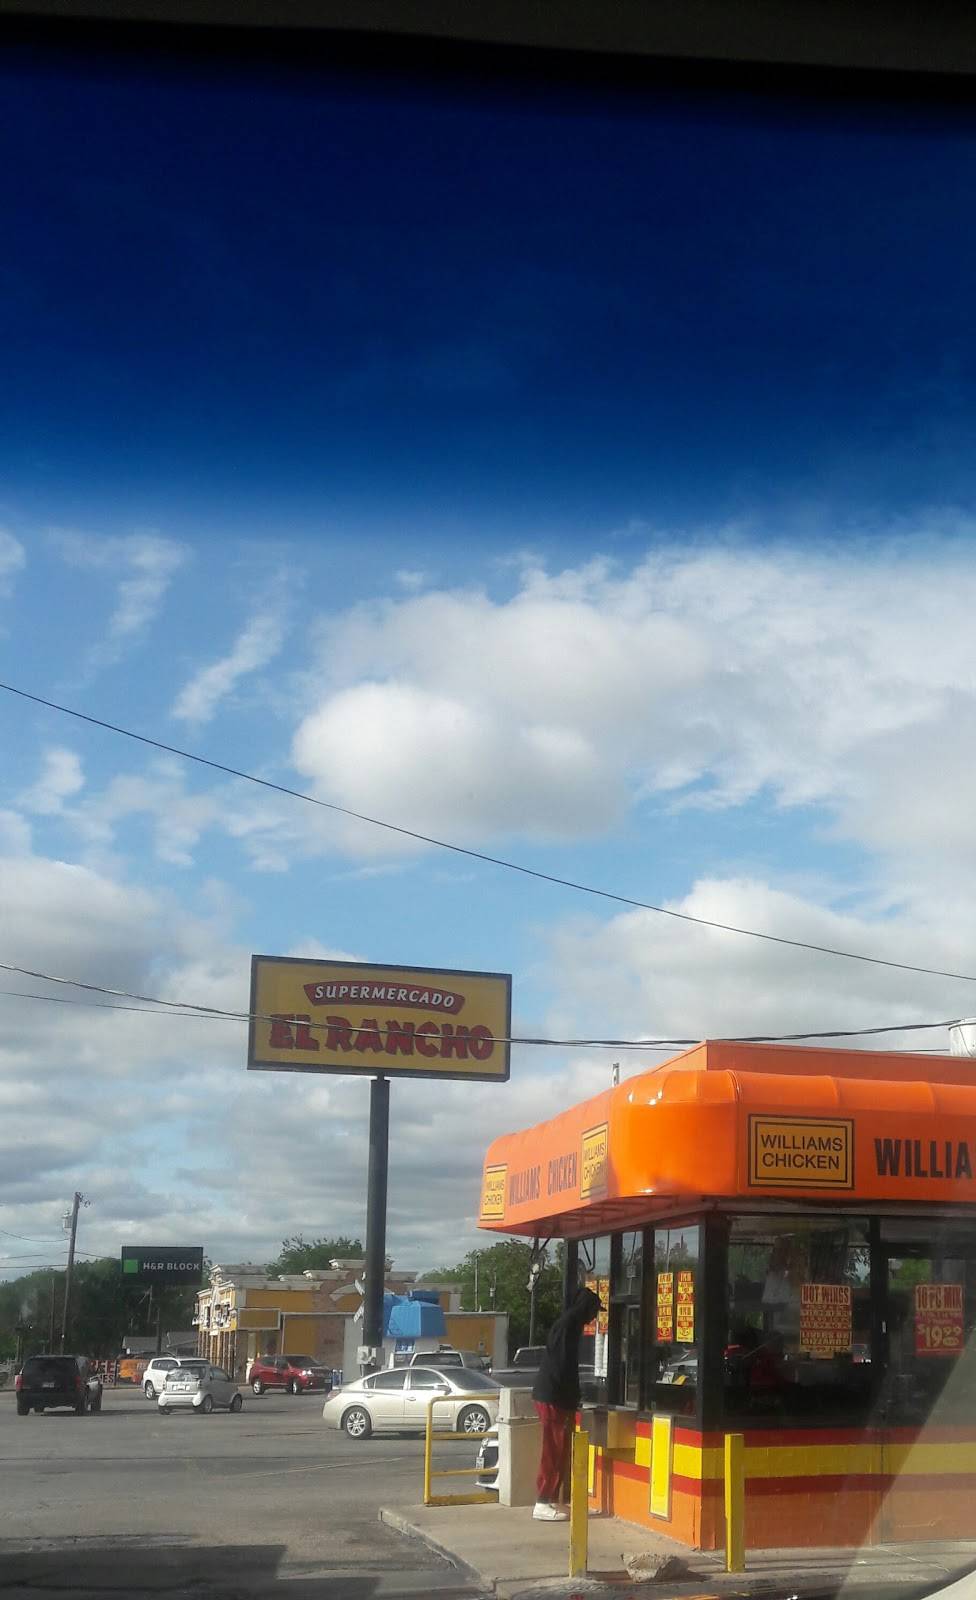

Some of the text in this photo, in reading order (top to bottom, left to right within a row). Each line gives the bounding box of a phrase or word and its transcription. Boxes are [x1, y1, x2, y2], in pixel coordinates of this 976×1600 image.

[314, 984, 456, 1009] SUPERMERCADO
[270, 1014, 495, 1061] EL RANCHO
[584, 1144, 605, 1160] WILLIAMS
[760, 1134, 843, 1152] WILLIAMS
[762, 1152, 840, 1170] CHICKEN
[509, 1151, 578, 1206] WILLIAMS CHICKEN
[583, 1163, 604, 1180] CHICKEN
[143, 1262, 200, 1271] H&R BLOCK
[801, 1286, 849, 1304] HOT WINGS
